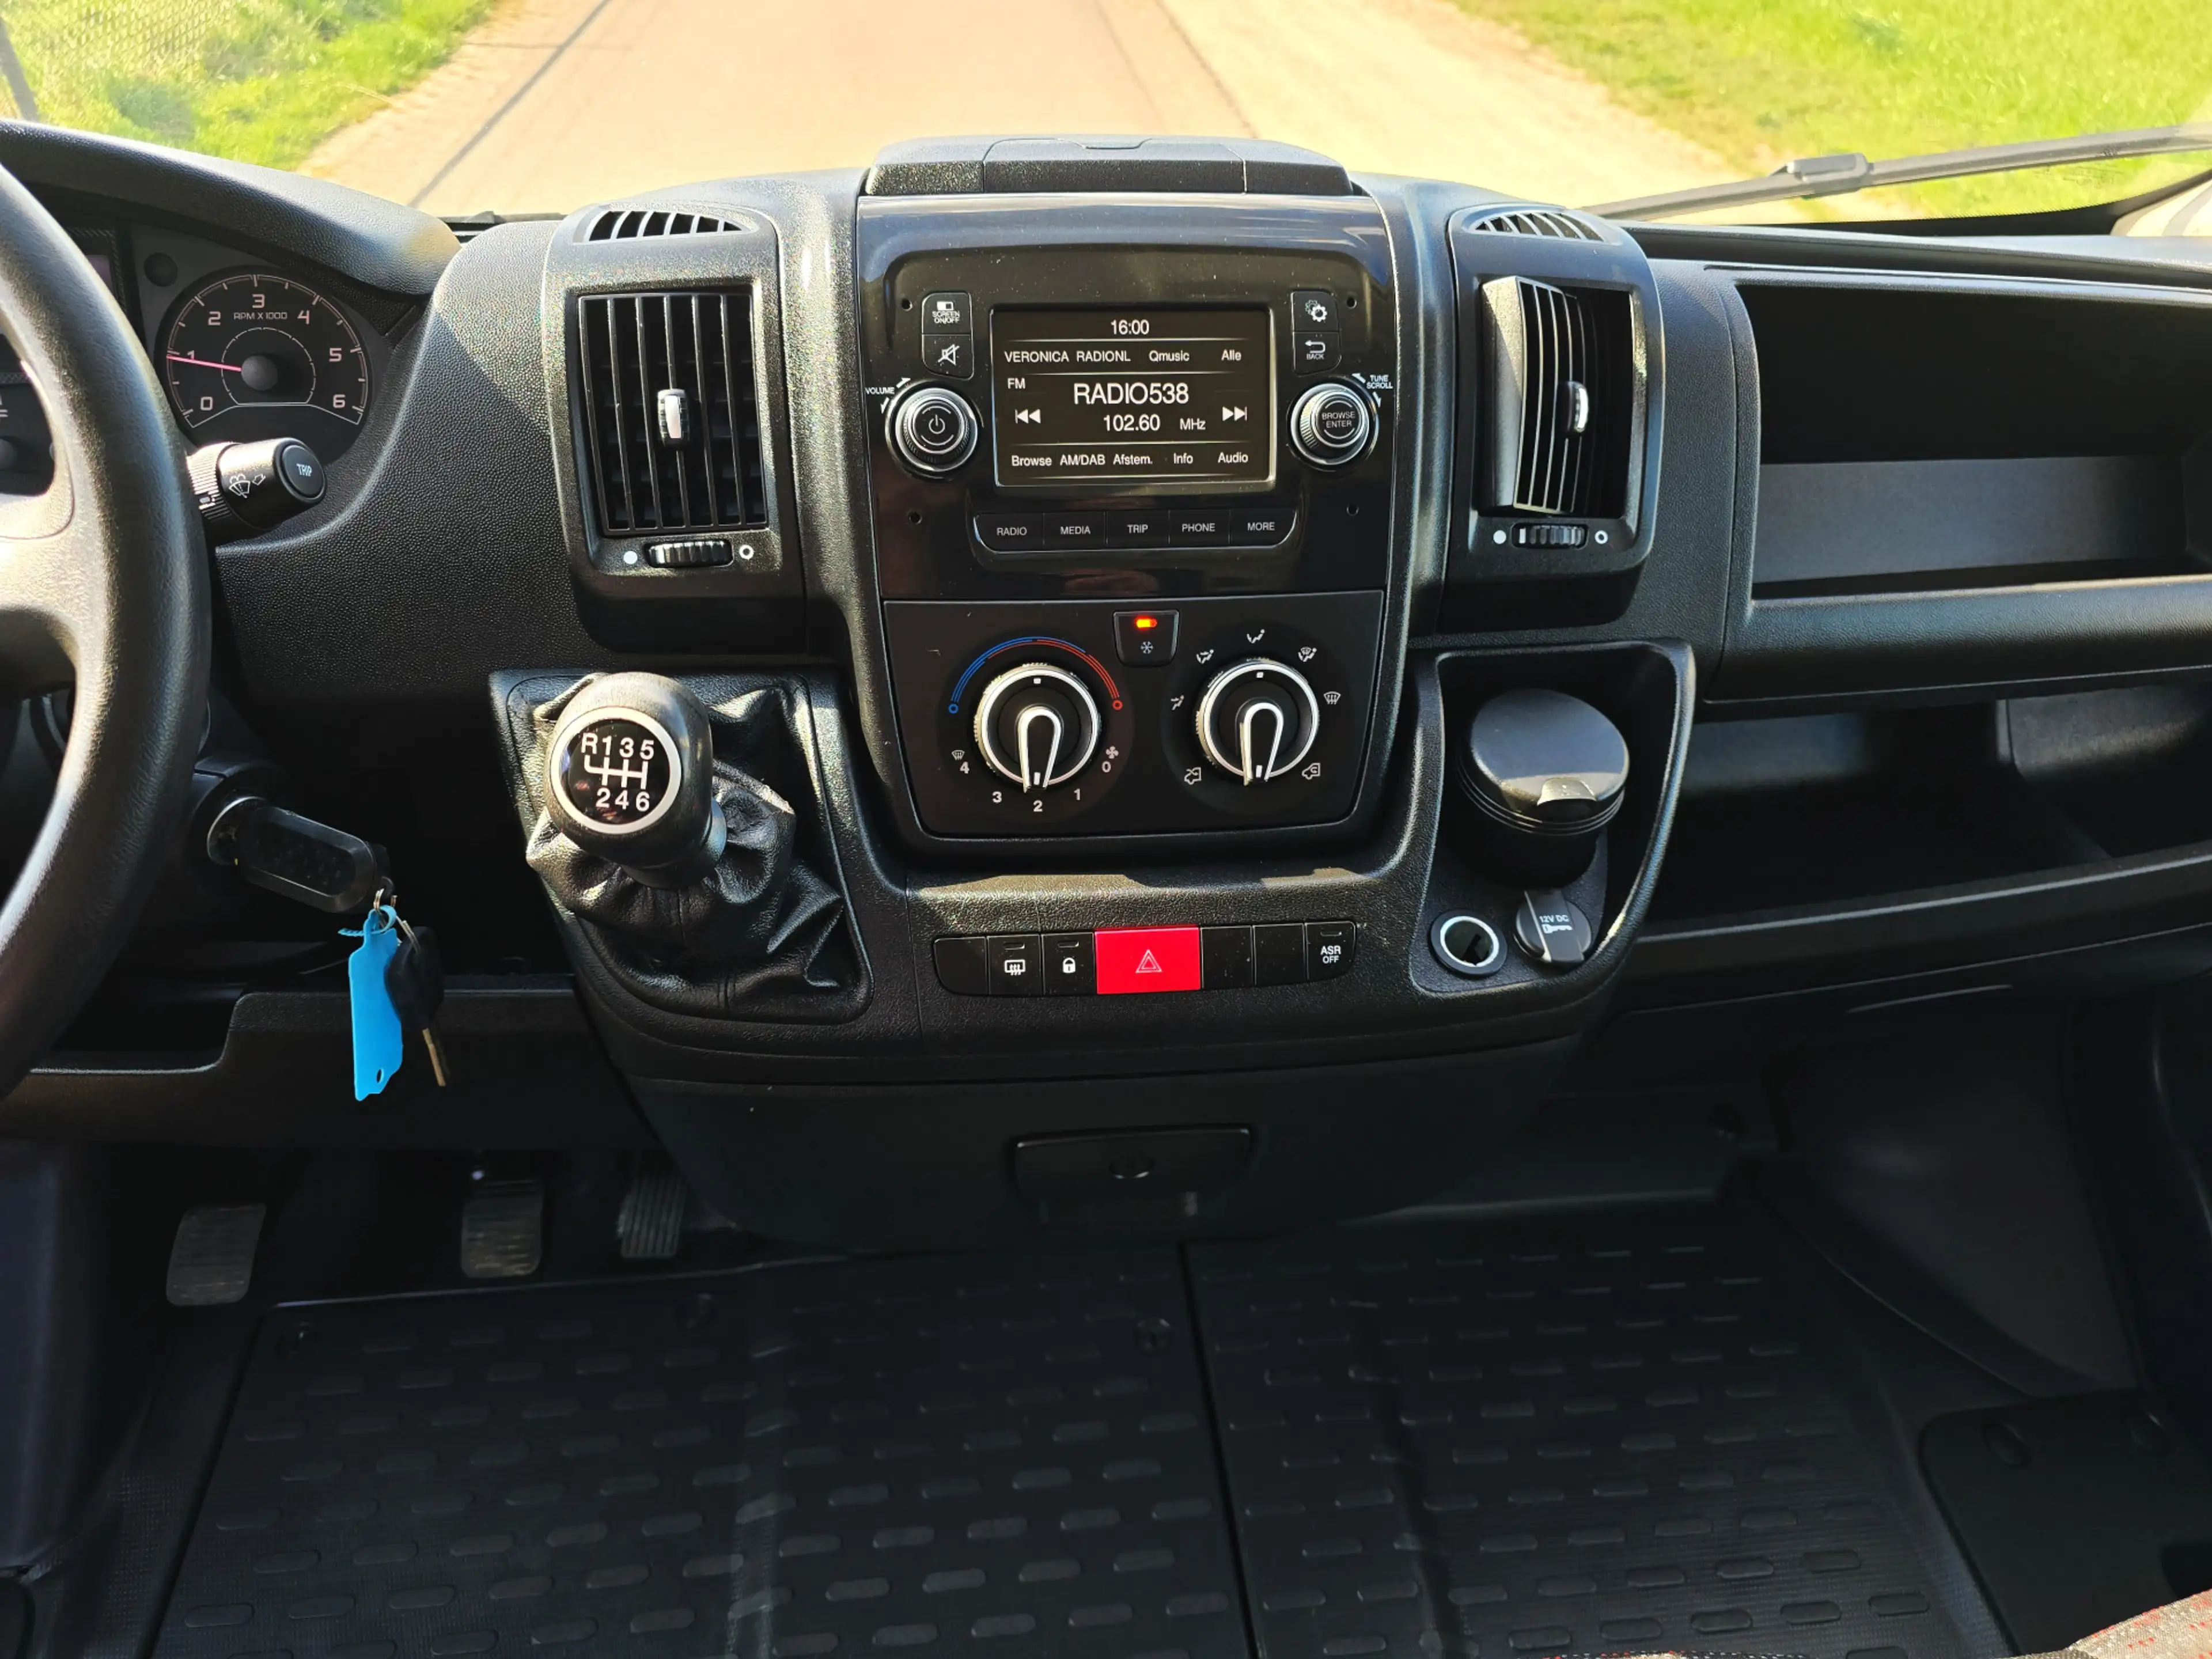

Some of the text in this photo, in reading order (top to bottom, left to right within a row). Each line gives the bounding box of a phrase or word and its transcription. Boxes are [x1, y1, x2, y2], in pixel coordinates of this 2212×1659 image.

[252, 294, 265, 309] 3
[208, 311, 221, 325] 2
[233, 312, 255, 320] RPM
[266, 312, 288, 320] 1000
[297, 310, 310, 325] 4
[1111, 319, 1150, 335] 16:00
[329, 347, 342, 362] 5
[1004, 349, 1242, 363] VERONICA RADIONL Qmusic Alle
[1007, 378, 1026, 389] FM
[1366, 381, 1393, 389] SCROLL
[865, 387, 895, 395] VOLUME
[1074, 383, 1189, 404] RADIO538
[200, 396, 213, 411] 0
[332, 394, 346, 408] 6
[1104, 414, 1206, 431] 102.60 MHz
[1321, 411, 1355, 421] BROWSE
[1326, 420, 1353, 429] ENTER
[1012, 452, 1249, 467] Browse AM/DAB Afstem. Info Audio
[296, 463, 312, 477] TRIP
[997, 522, 1275, 536] RADIO MEDIA TRIP PHONE MORE
[960, 761, 969, 774] 4
[1101, 761, 1112, 773] 0
[992, 791, 1002, 804] 3
[1073, 788, 1081, 801] 1
[1033, 800, 1043, 812] 2
[1539, 914, 1570, 923] 12V DC
[1320, 945, 1342, 955] ASR
[1322, 955, 1340, 964] OFF
